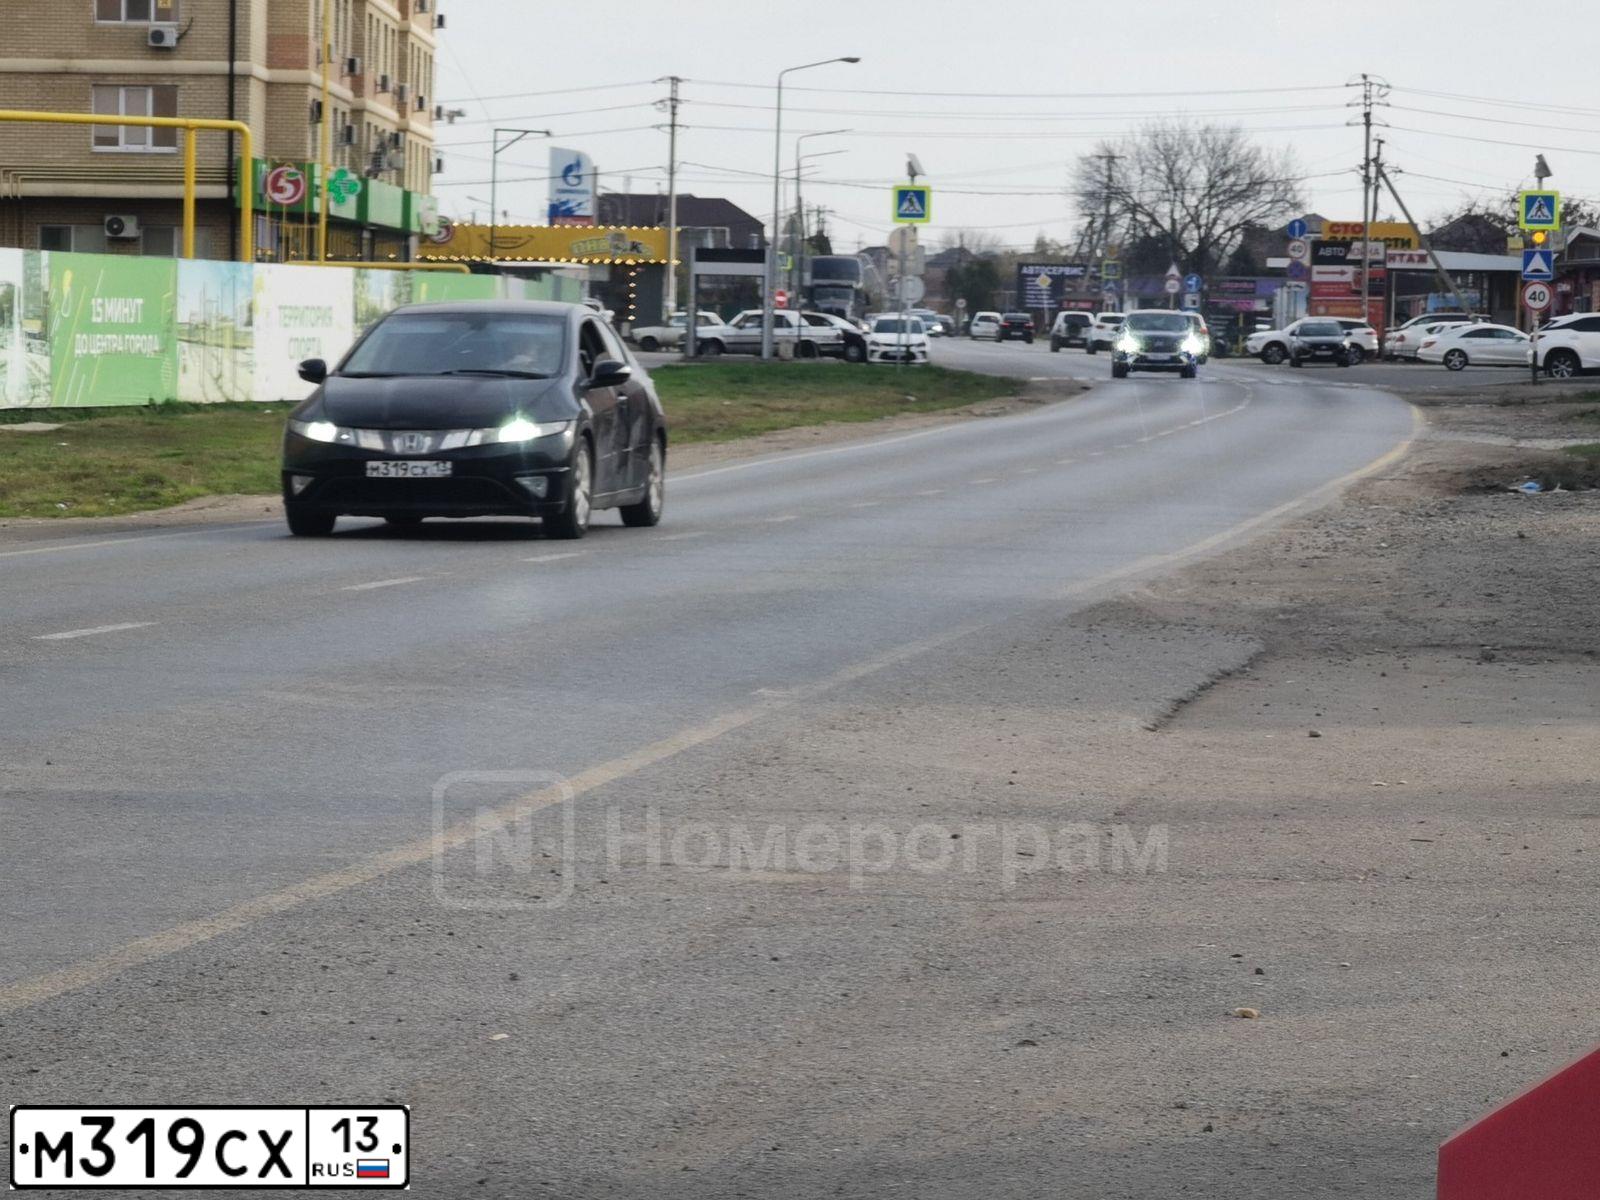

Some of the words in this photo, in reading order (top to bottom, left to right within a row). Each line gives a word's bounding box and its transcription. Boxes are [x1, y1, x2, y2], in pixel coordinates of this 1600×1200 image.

[1328, 223, 1364, 234] СТО
[1318, 247, 1345, 256] АВТО
[1021, 265, 1084, 275] АВТОСЕРВИС
[1528, 290, 1546, 302] 40
[91, 298, 103, 323] 15
[104, 298, 144, 323] МИНУТ
[74, 334, 88, 357] ДО
[89, 334, 122, 357] ЦЕНТРА
[124, 334, 160, 357] ГОРОДА
